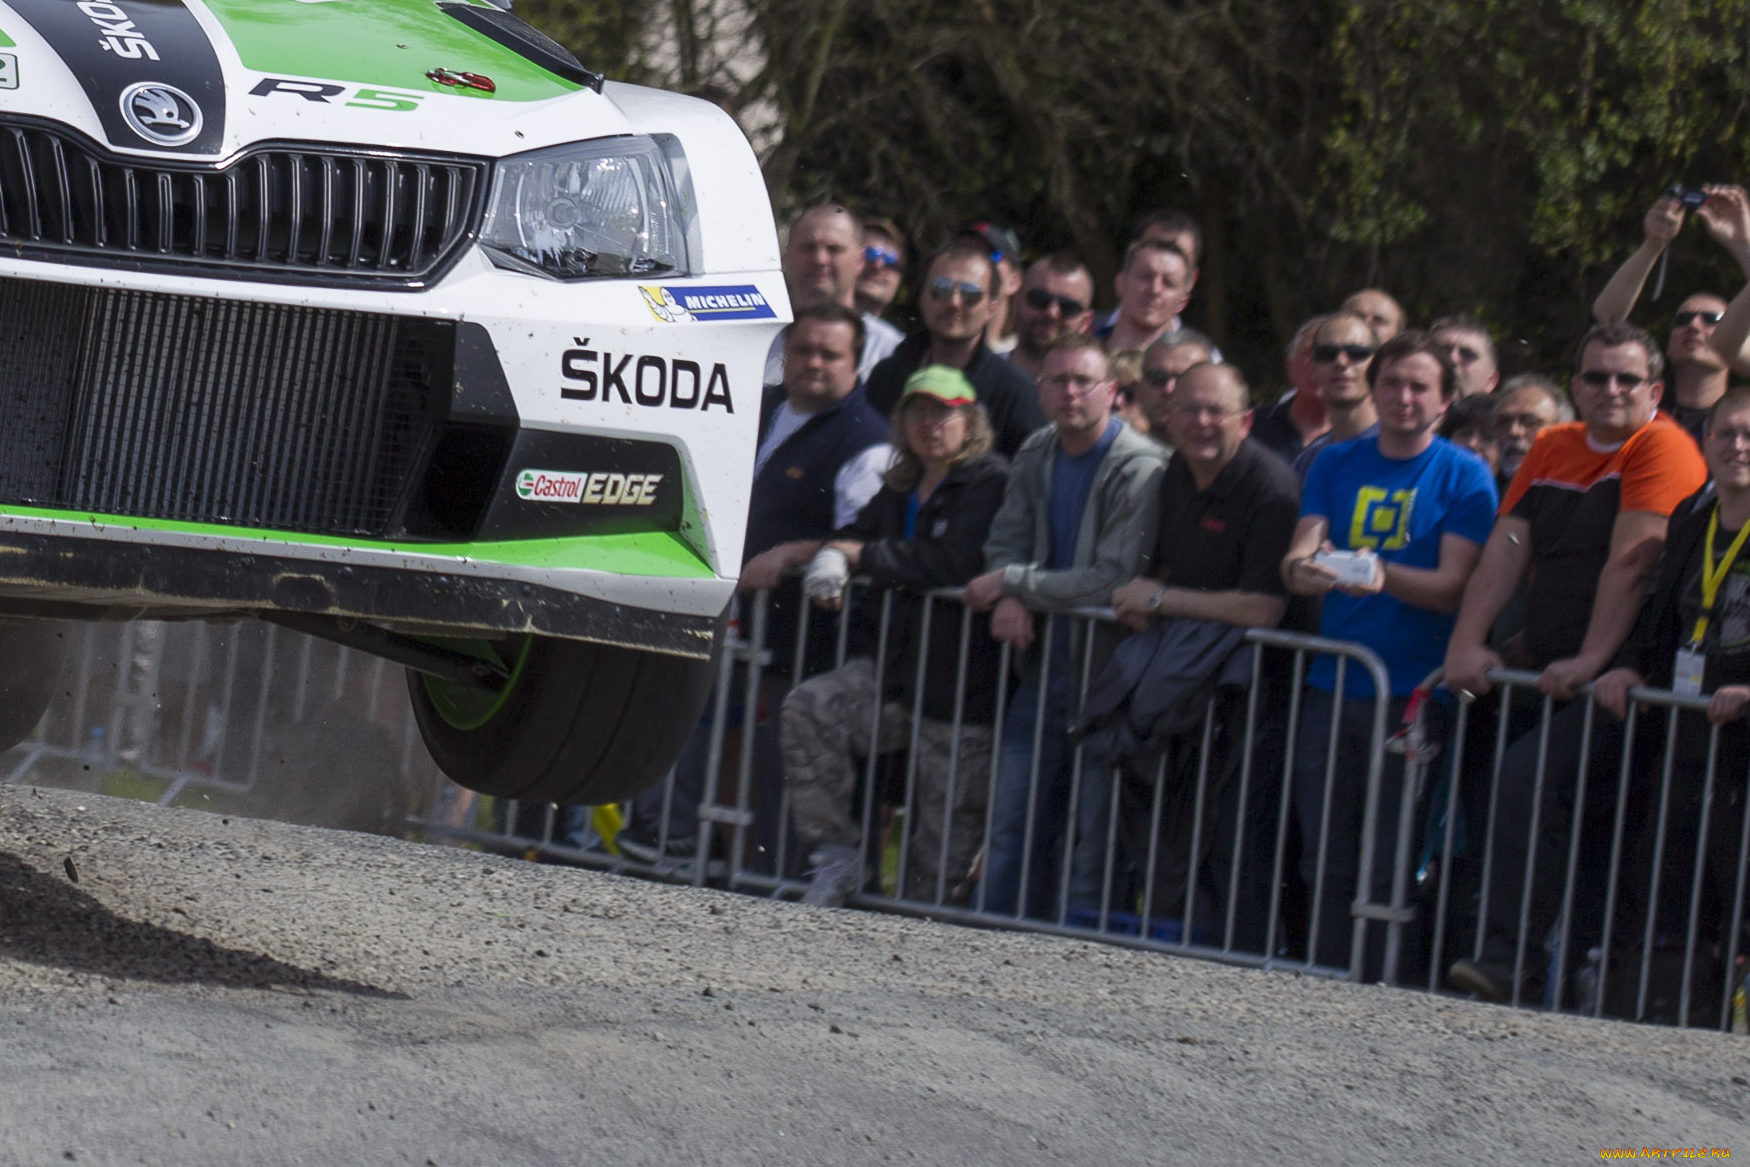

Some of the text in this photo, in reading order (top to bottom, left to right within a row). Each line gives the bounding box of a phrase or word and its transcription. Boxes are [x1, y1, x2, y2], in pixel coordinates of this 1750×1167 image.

[248, 77, 426, 112] R5
[684, 291, 765, 310] MICHELIN
[560, 336, 735, 415] ŠKODA
[533, 472, 665, 506] Castrol EDGE
